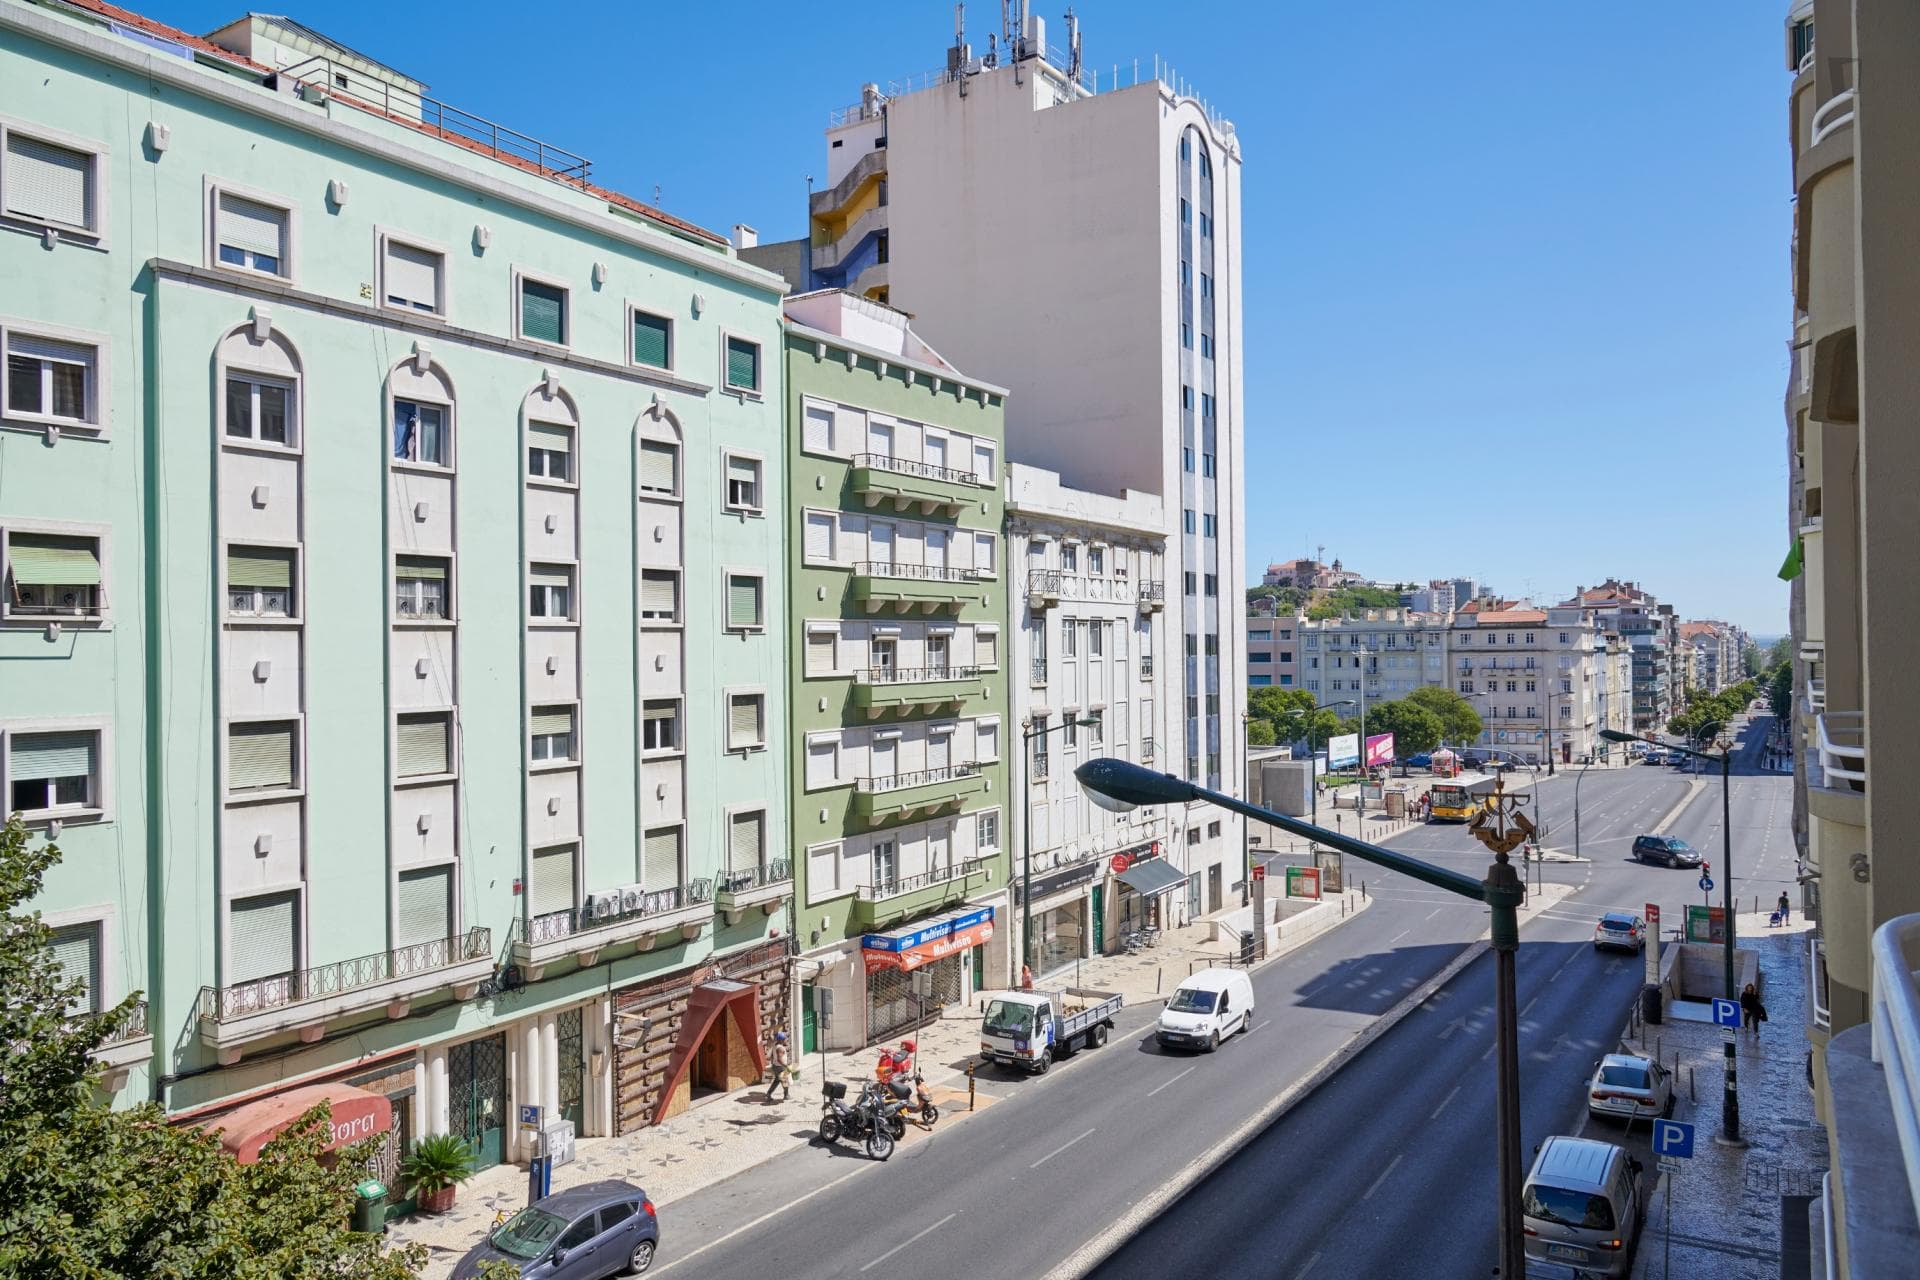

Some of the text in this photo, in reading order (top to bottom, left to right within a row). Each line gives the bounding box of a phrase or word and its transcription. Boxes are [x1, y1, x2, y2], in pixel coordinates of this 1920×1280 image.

[1718, 1002, 1735, 1023] P
[522, 1107, 531, 1122] P
[1663, 1125, 1685, 1152] P
